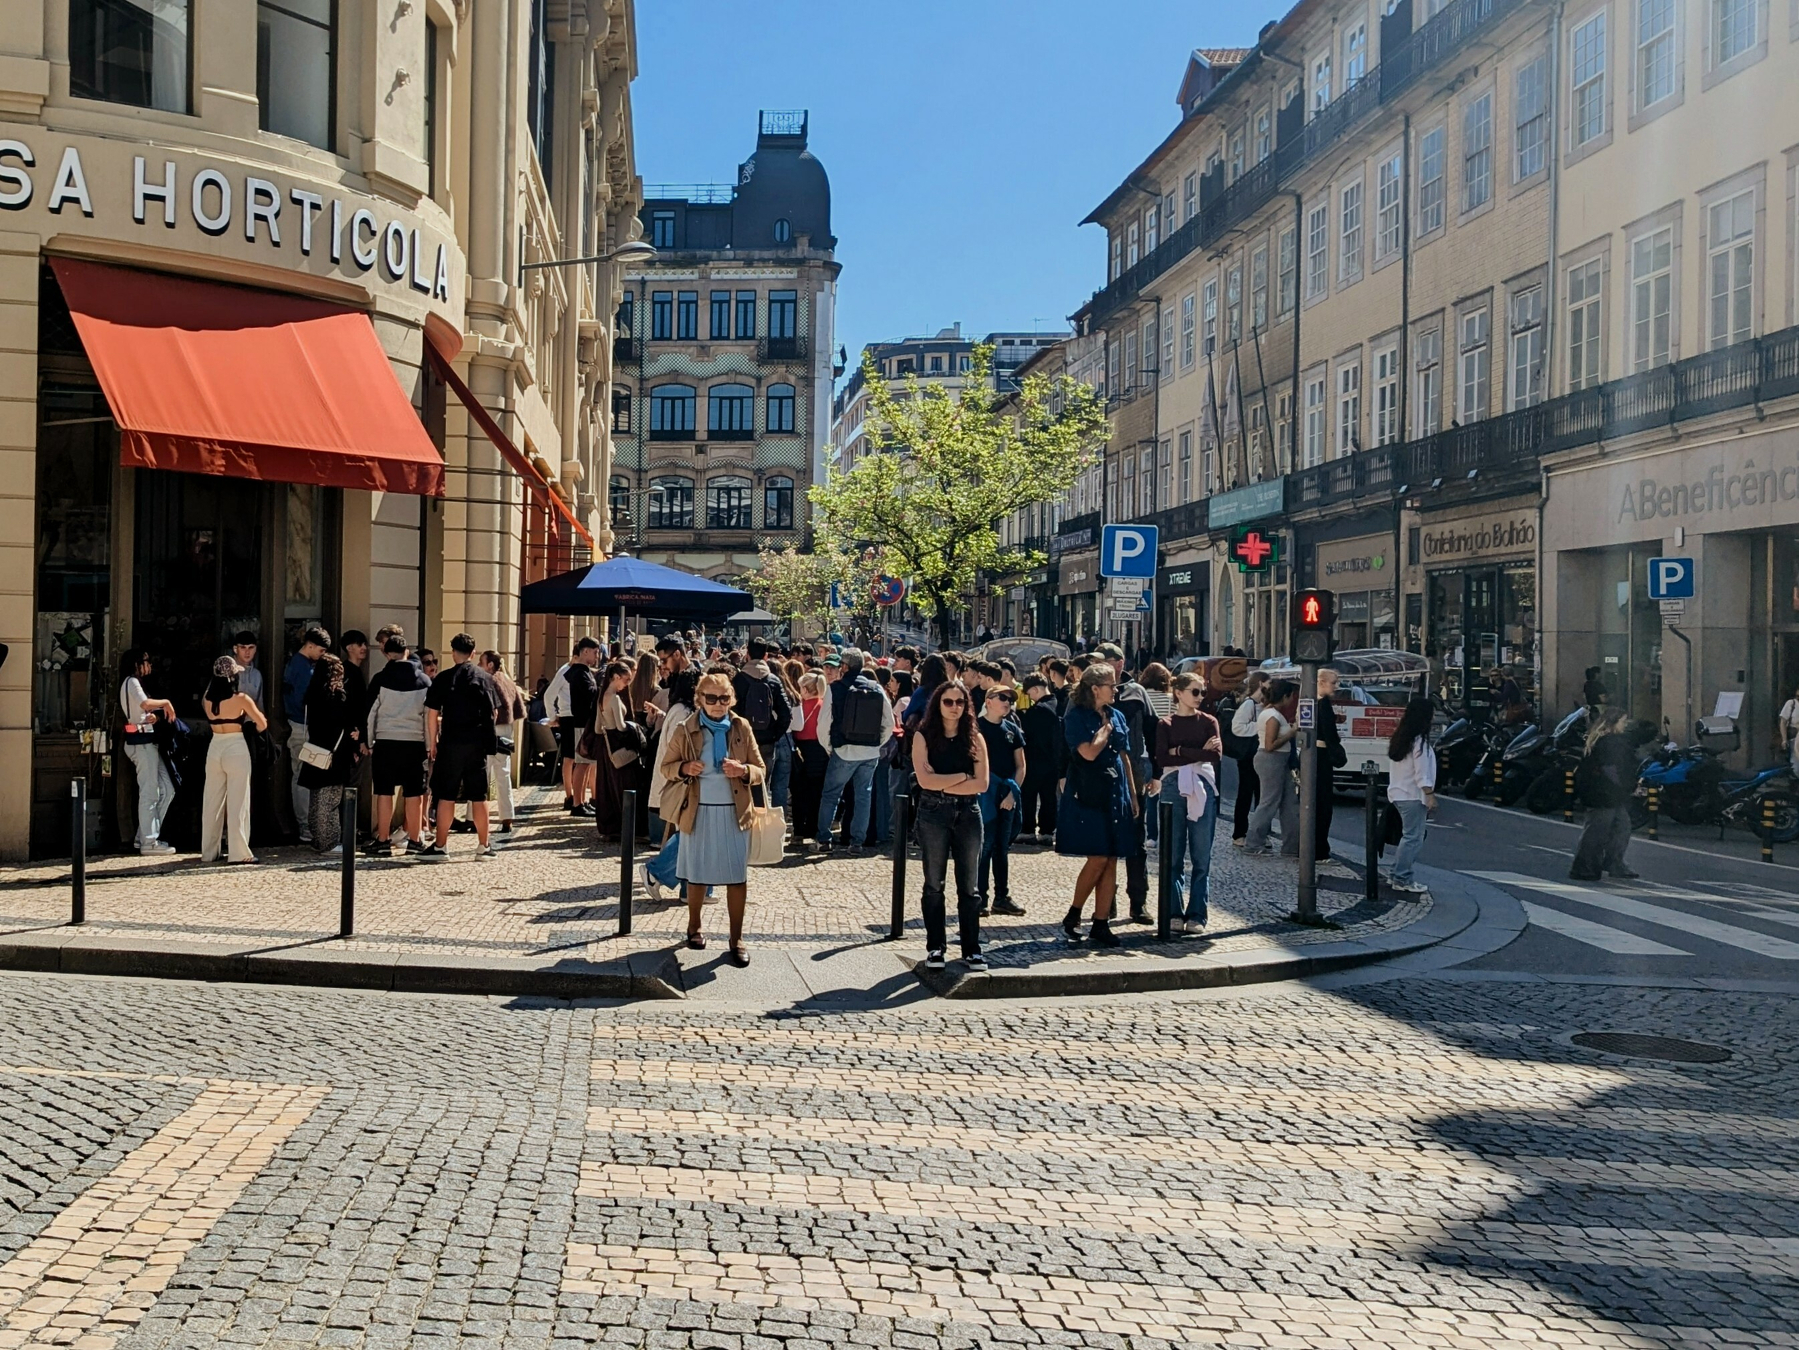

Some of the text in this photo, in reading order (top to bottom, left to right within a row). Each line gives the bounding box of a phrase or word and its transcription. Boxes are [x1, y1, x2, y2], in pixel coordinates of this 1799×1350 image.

[134, 156, 448, 300] HORTICOLA
[1113, 530, 1145, 572] P
[1475, 523, 1491, 550] do
[1169, 571, 1192, 586] XTREME
[1659, 562, 1684, 595] P
